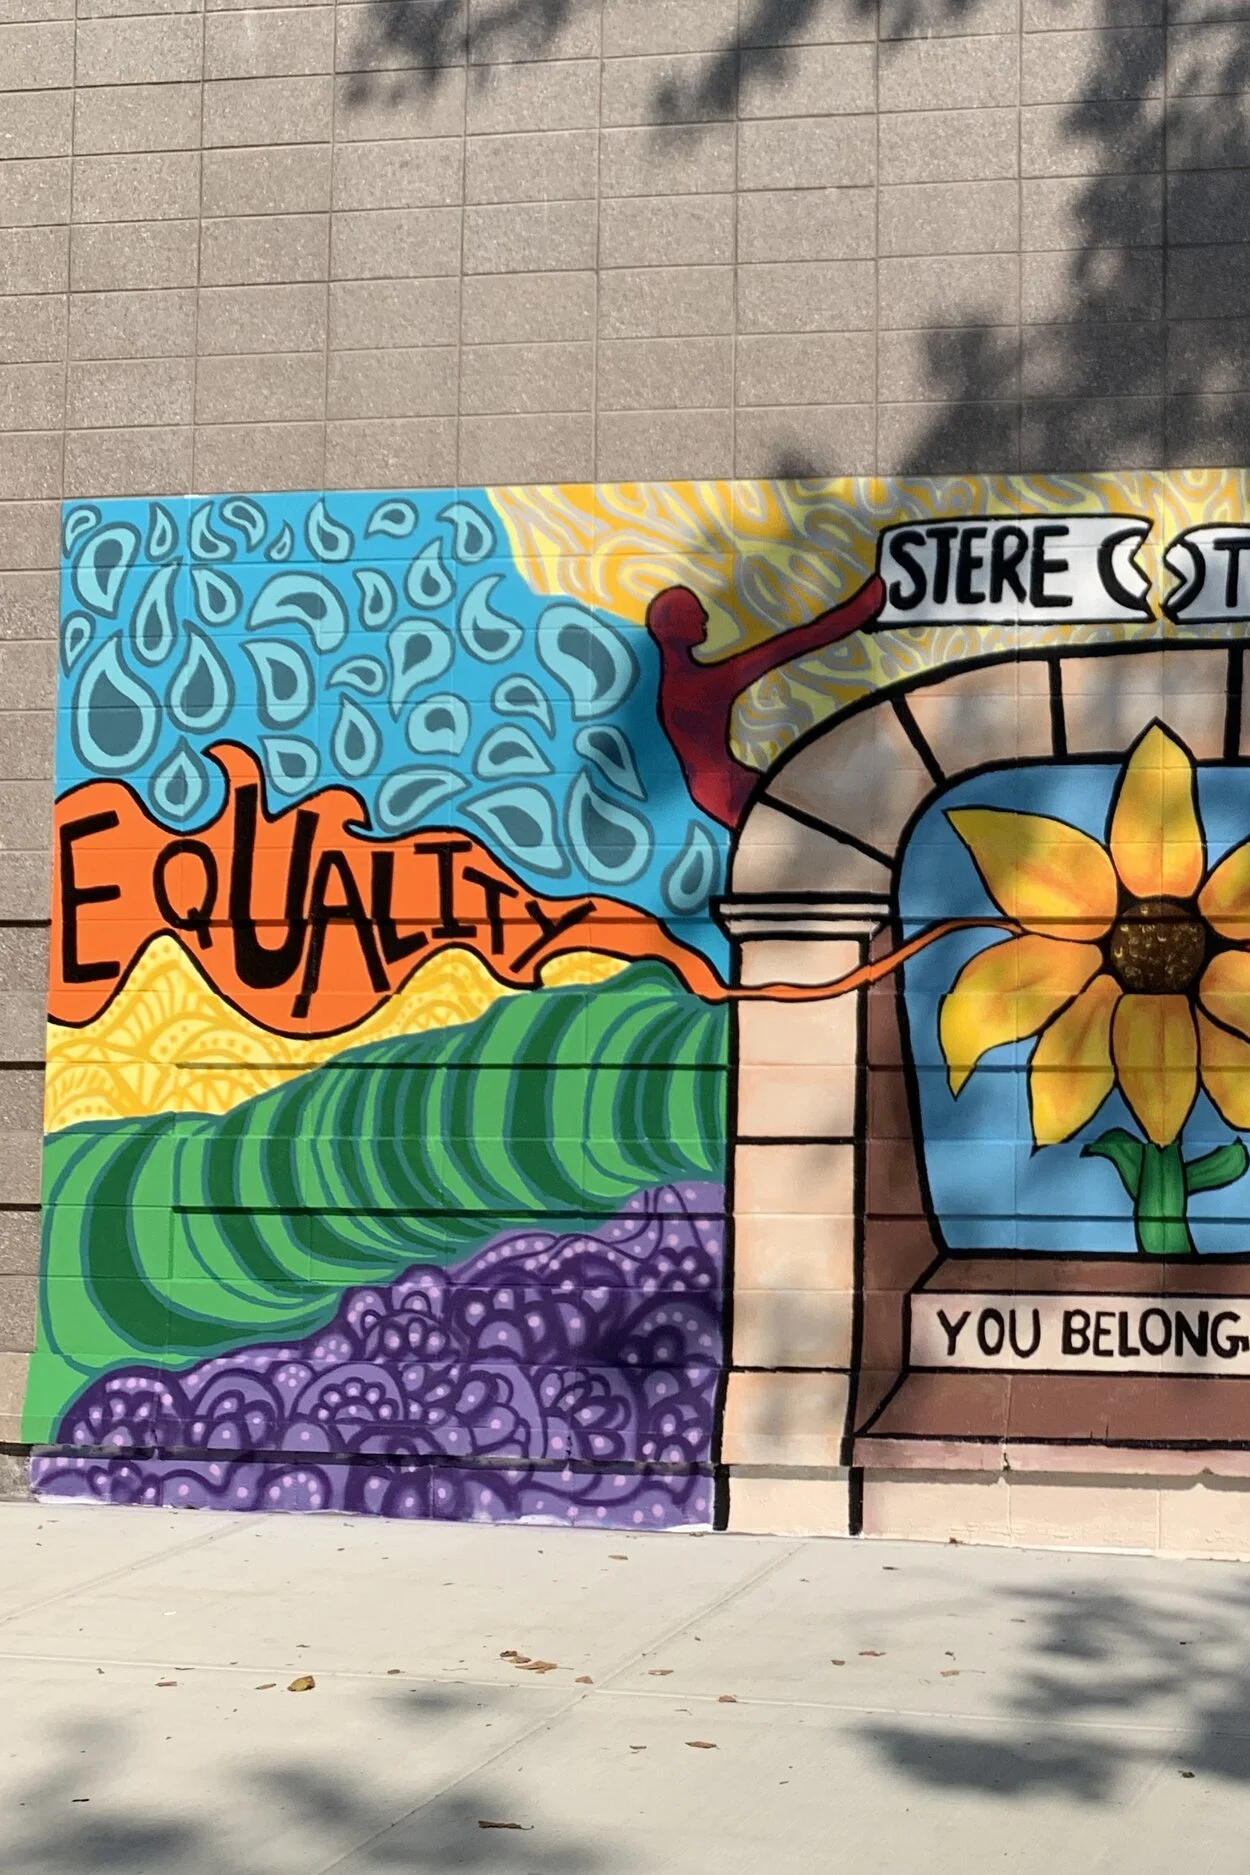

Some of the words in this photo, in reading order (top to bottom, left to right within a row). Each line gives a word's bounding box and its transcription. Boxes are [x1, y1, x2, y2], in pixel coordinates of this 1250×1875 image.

[58, 781, 599, 1020] EQUALITY
[936, 1307, 1042, 1359] YOU
[1061, 1307, 1250, 1360] BELONG
